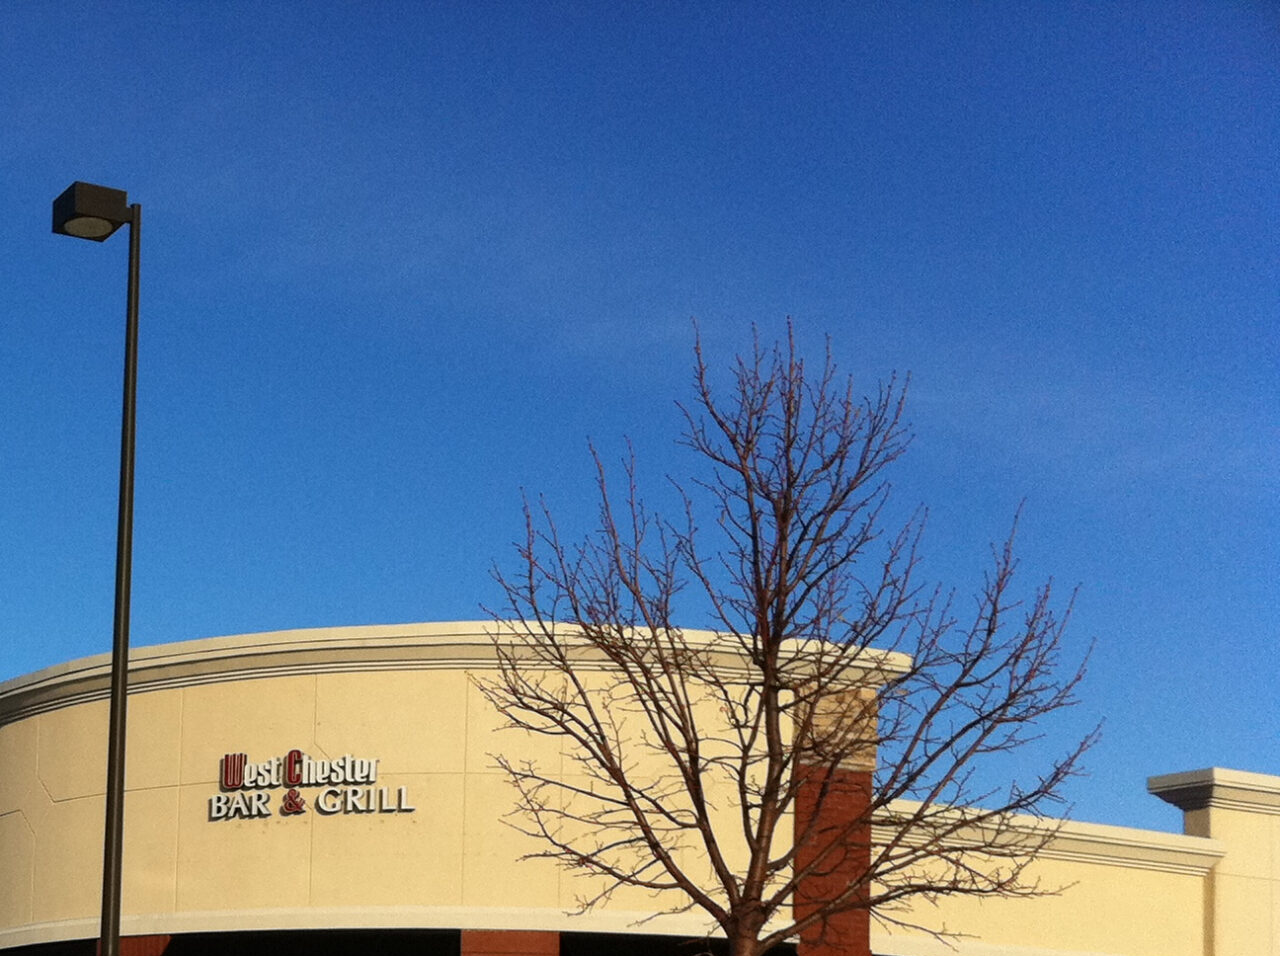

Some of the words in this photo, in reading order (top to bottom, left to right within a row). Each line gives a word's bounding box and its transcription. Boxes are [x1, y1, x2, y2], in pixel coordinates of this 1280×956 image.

[221, 753, 281, 790] West
[284, 749, 378, 787] Chester
[210, 792, 271, 820] BAR
[280, 788, 305, 815] &
[316, 786, 415, 815] GRILL
